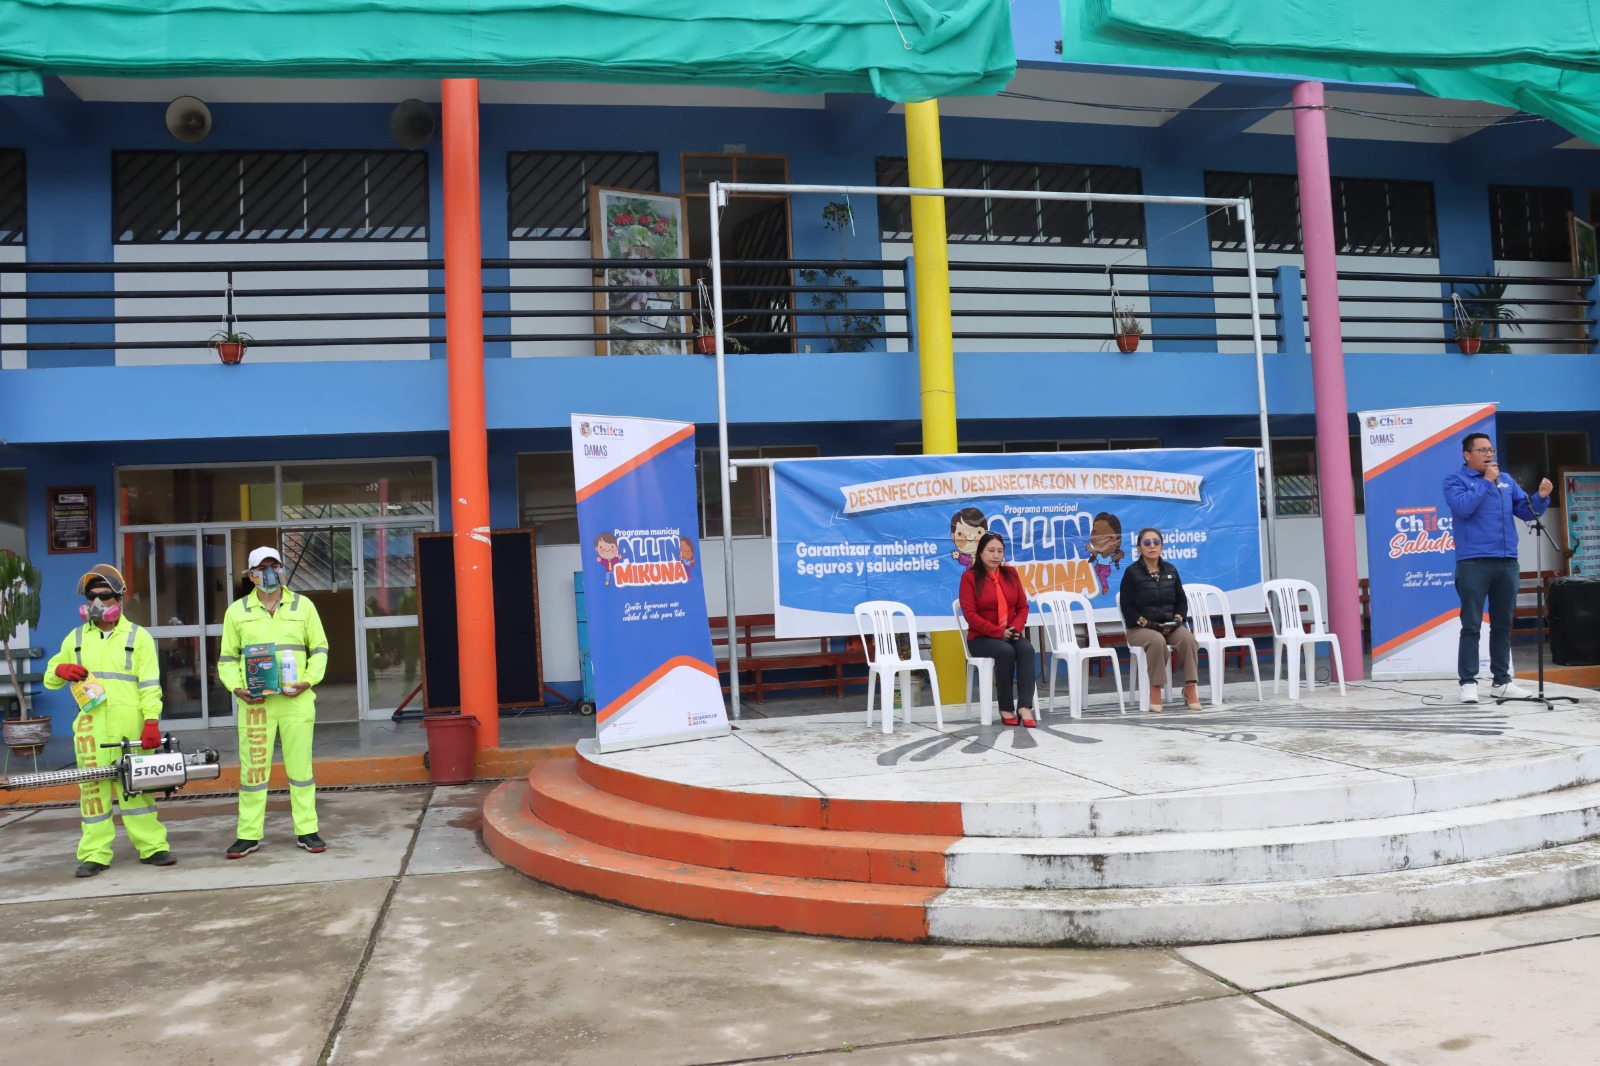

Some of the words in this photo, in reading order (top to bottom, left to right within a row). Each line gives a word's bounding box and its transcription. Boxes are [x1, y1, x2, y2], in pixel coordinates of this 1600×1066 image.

[1370, 433, 1395, 445] DAMAS
[584, 444, 608, 456] DAMAS
[849, 476, 957, 509] DESINFECCIÓN,
[961, 471, 1076, 493] DESINSECTACIÓN
[1080, 473, 1089, 490] Y
[1093, 473, 1197, 496] DESRATIZACIÓN
[1004, 505, 1040, 516] Programa
[1042, 502, 1078, 513] municipal
[614, 528, 649, 538] Programa
[651, 527, 680, 537] municipal
[617, 538, 681, 564] ALLIN
[796, 541, 870, 558] Garantizar
[873, 540, 937, 556] ambiente
[615, 562, 686, 585] MIKUNA
[797, 559, 853, 578] Seguros
[856, 561, 864, 576] y
[866, 556, 940, 573] saludables
[1001, 560, 1096, 598] KUNA
[133, 762, 182, 778] STRONG
